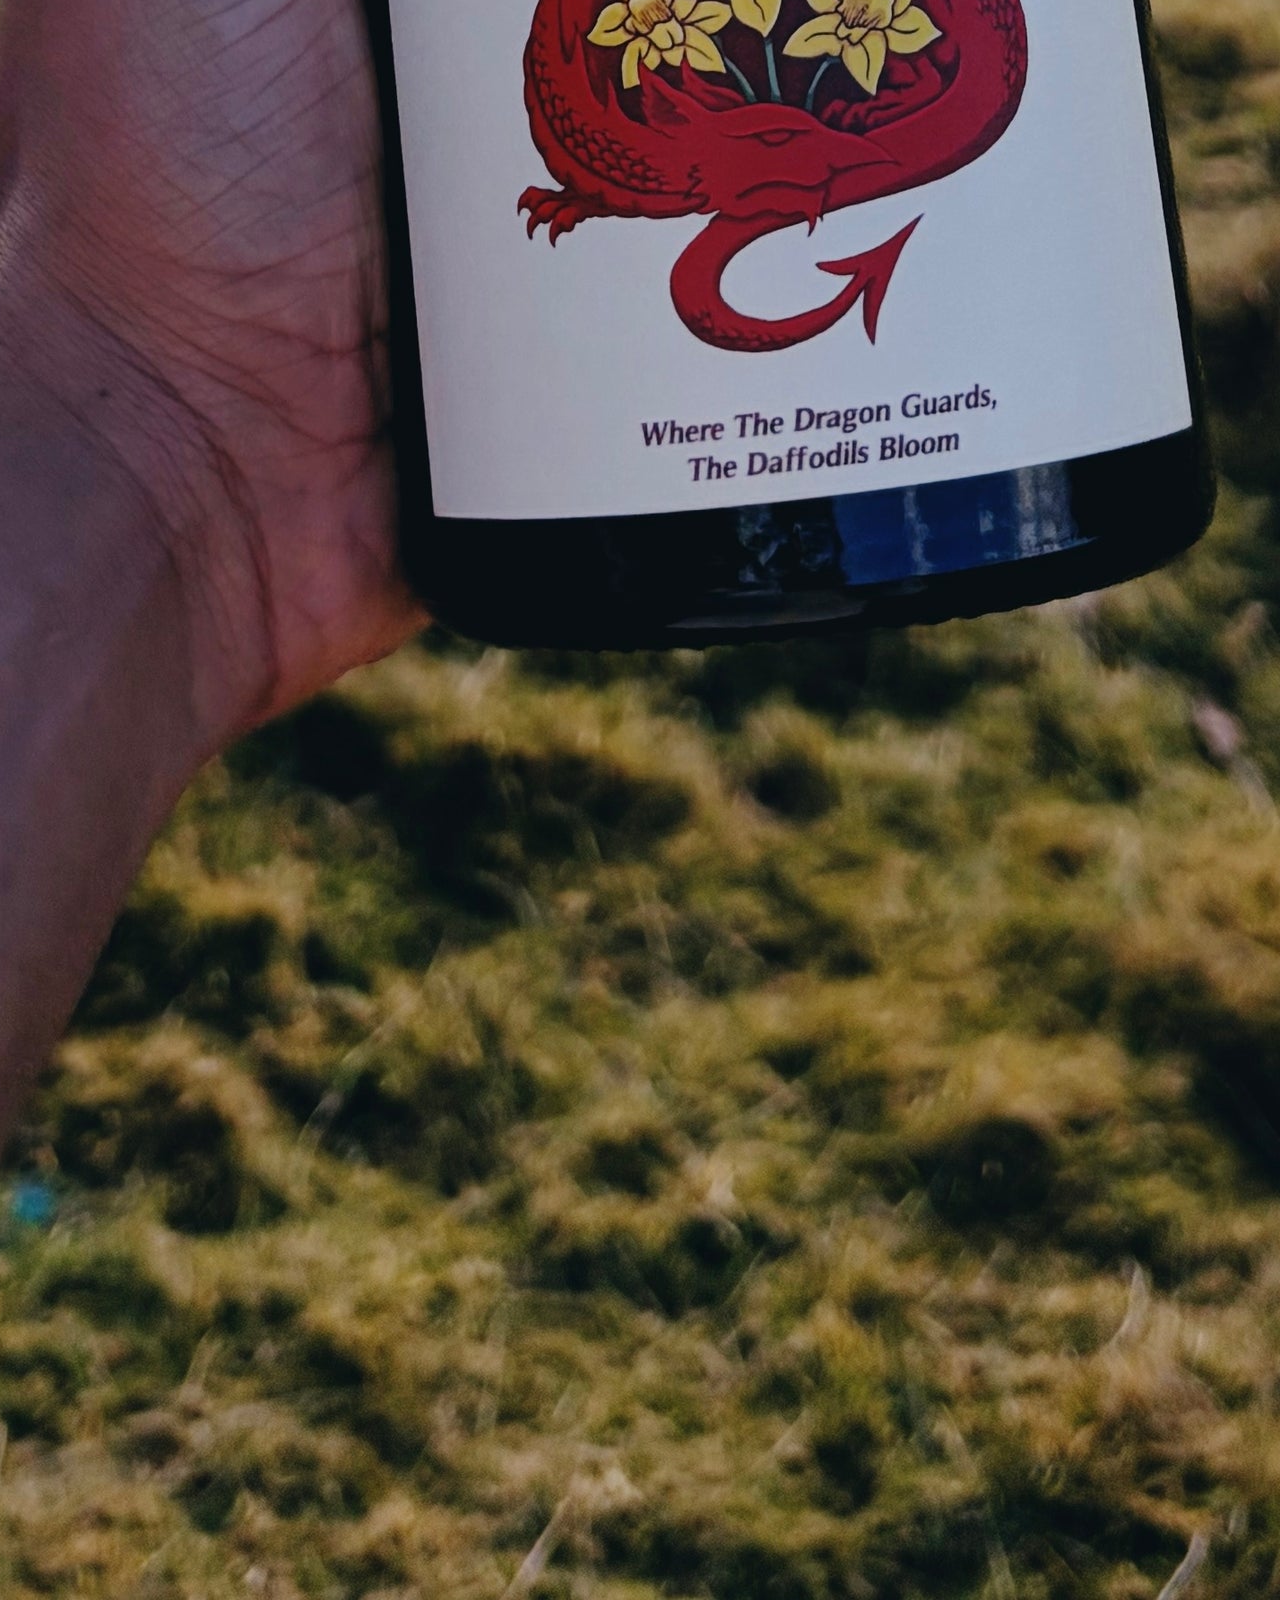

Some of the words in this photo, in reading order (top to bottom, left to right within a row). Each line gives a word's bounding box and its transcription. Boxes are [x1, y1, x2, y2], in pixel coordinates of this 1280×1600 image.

[641, 420, 725, 448] Where
[734, 412, 784, 439] The
[794, 401, 892, 434] Dragon
[901, 383, 998, 419] Guards,
[687, 455, 738, 482] The
[747, 440, 869, 477] Daffodils
[878, 430, 960, 461] Bloom
